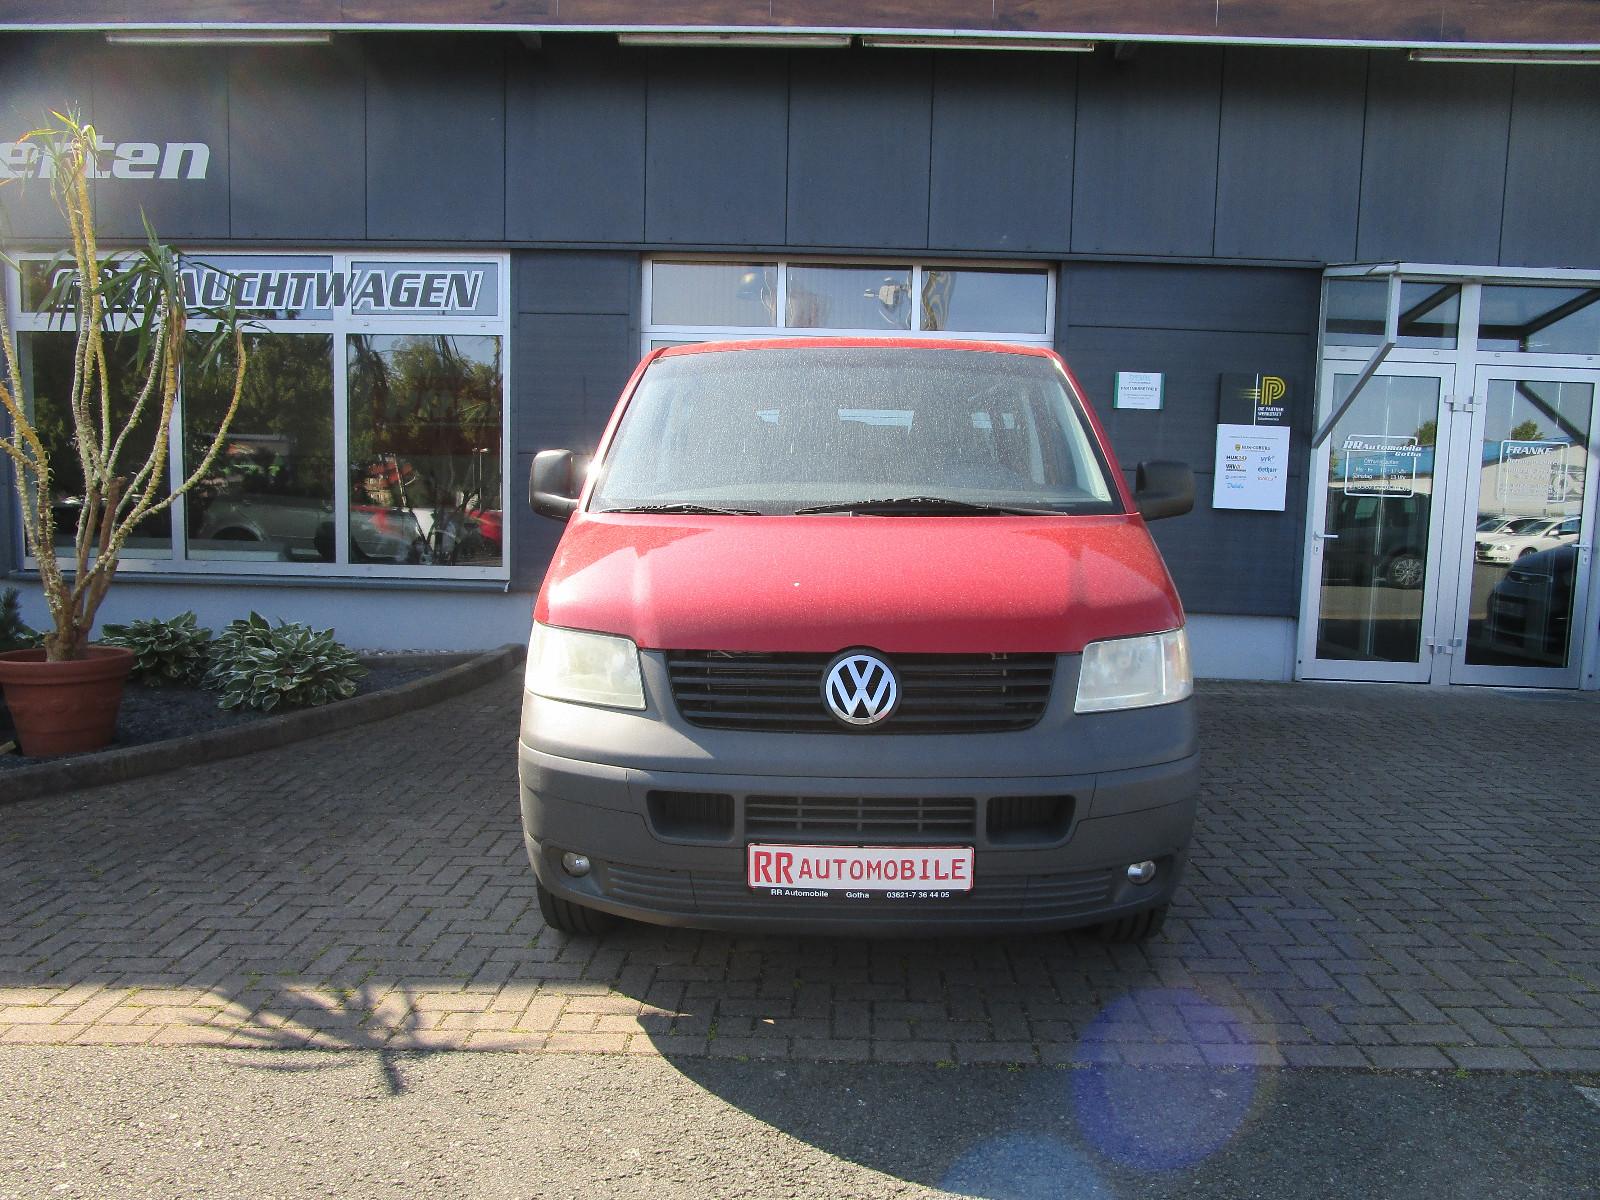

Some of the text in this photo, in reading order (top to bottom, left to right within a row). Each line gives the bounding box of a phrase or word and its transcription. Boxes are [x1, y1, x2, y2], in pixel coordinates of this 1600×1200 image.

[754, 851, 967, 884] RR AUTOMOBILE
[770, 888, 950, 899] RR Automobile Gotha 03621-7 36 44 05
